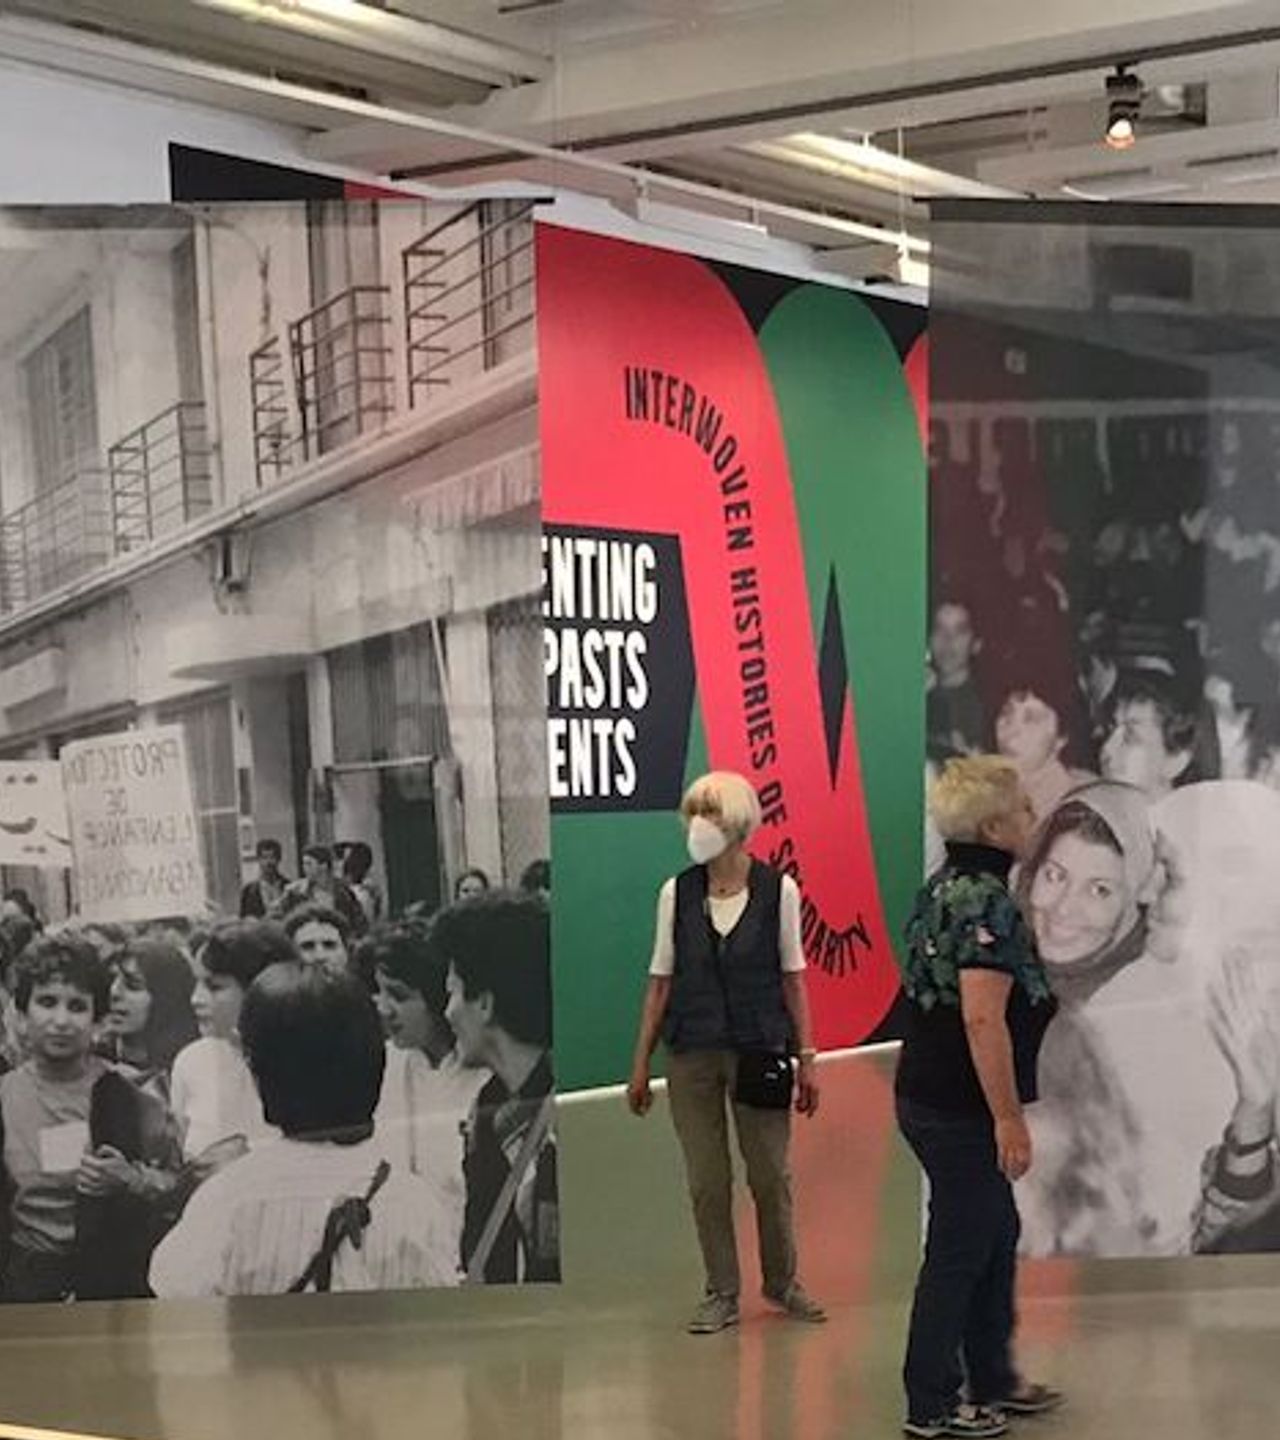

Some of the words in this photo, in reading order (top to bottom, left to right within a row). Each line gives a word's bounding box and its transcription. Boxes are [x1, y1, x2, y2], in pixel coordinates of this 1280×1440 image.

[624, 365, 754, 551] INTERWOVEN
[543, 628, 649, 710] PASTS
[730, 567, 777, 770] HISTORIES
[547, 717, 638, 798] ENTS
[758, 780, 787, 827] OF
[769, 838, 872, 978] SODARITY
